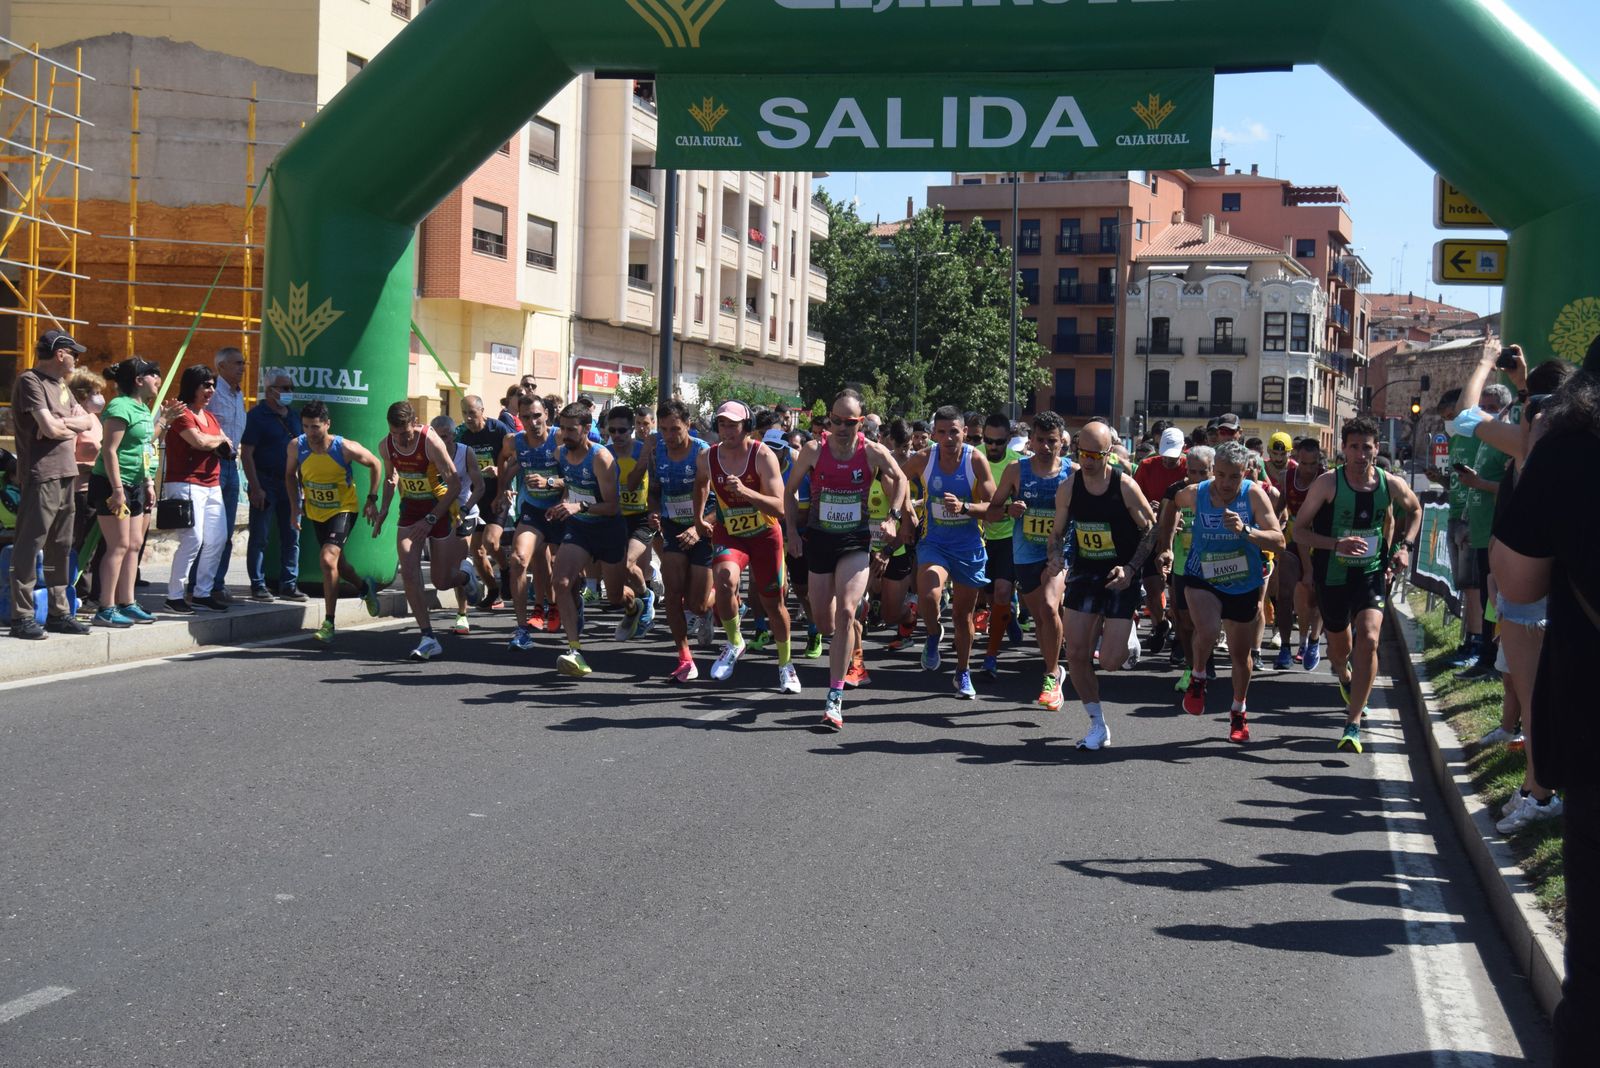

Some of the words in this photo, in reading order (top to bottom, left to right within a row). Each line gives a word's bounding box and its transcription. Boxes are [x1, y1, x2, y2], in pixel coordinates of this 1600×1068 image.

[757, 96, 1098, 149] SALIDA
[702, 135, 742, 147] RURAL
[1147, 133, 1190, 145] RURAL
[402, 479, 427, 492] 182
[310, 489, 335, 501] 139
[729, 514, 759, 532] 227
[826, 511, 854, 522] GARGAR
[1083, 533, 1103, 549] 49
[1213, 564, 1238, 577] MANSO
